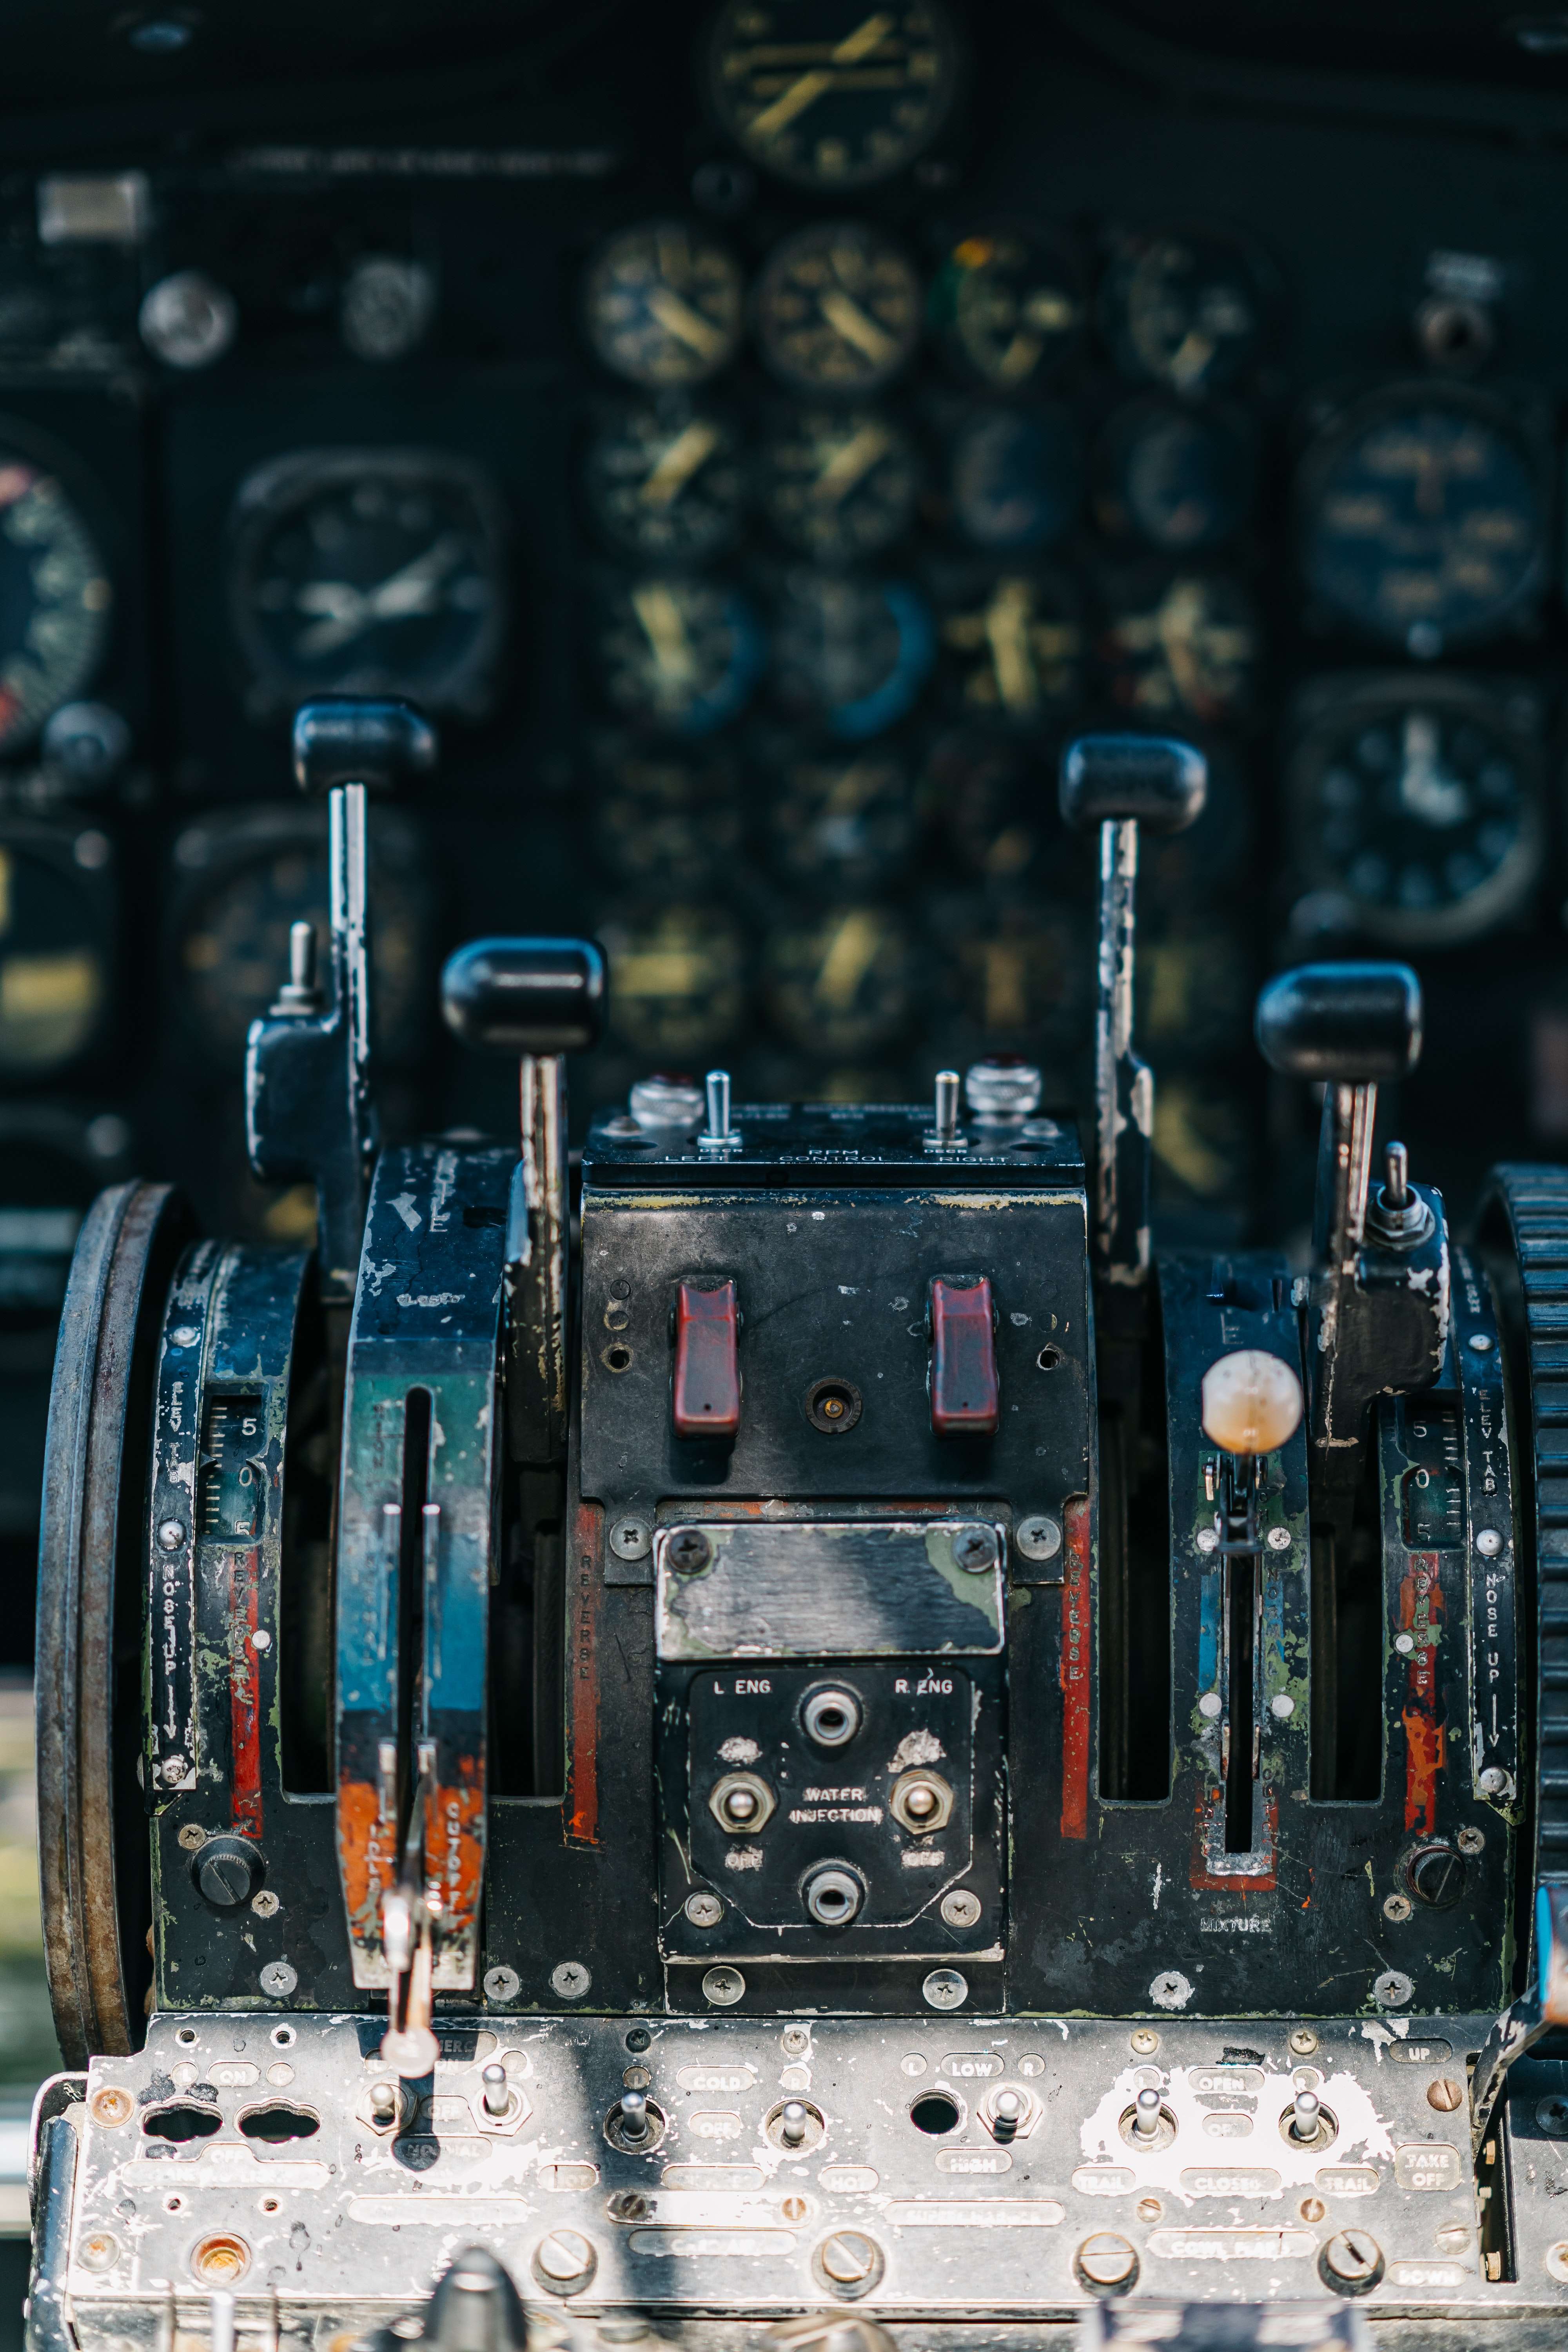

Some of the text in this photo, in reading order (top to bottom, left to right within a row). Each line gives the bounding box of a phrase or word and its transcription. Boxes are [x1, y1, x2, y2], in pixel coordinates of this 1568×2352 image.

[168, 1381, 185, 1484] ELEV TAB
[241, 1417, 258, 1436] 5
[1413, 1421, 1427, 1438] 5
[1479, 1389, 1497, 1492] ELEV TAB
[238, 1466, 253, 1486] 0
[1415, 1468, 1430, 1488] 0
[235, 1520, 250, 1535] 5
[1417, 1523, 1431, 1542] 5
[162, 1564, 176, 1676] NOSE UP
[232, 1551, 248, 1678] REVERSE
[580, 1555, 591, 1679] REVERSE
[1069, 1553, 1082, 1680] REVERSE
[1416, 1558, 1429, 1685] REVERSE
[1485, 1573, 1500, 1683] NOSE UP
[714, 1680, 771, 1694] L ENG
[917, 1679, 953, 1694] ENG
[806, 1788, 864, 1801] WATER
[793, 1808, 880, 1823] INJECTION
[727, 1854, 760, 1867] OFF
[907, 1853, 941, 1866] OFF
[1200, 1917, 1272, 1933] MIXTURE
[1409, 2047, 1430, 2060] UP
[183, 2068, 192, 2082] L
[909, 2062, 918, 2075] L
[951, 2062, 993, 2076] LOW
[1024, 2062, 1034, 2076] R
[220, 2070, 246, 2083] ON
[693, 2076, 740, 2090] COLD
[1199, 2077, 1245, 2091] OPEN
[1296, 2078, 1307, 2091] R
[428, 2104, 461, 2118] OFF
[700, 2122, 734, 2135] OFF
[211, 2149, 243, 2163] OFF
[1405, 2154, 1449, 2168] TAKE
[950, 2158, 997, 2173] HIGH
[1079, 2177, 1125, 2190] TRAIL
[1194, 2178, 1260, 2191] CLOSED
[1325, 2178, 1371, 2192] TRAIL
[1412, 2173, 1445, 2187] OFF
[1171, 2241, 1227, 2255] COWL
[1399, 2270, 1455, 2285] DOWN
